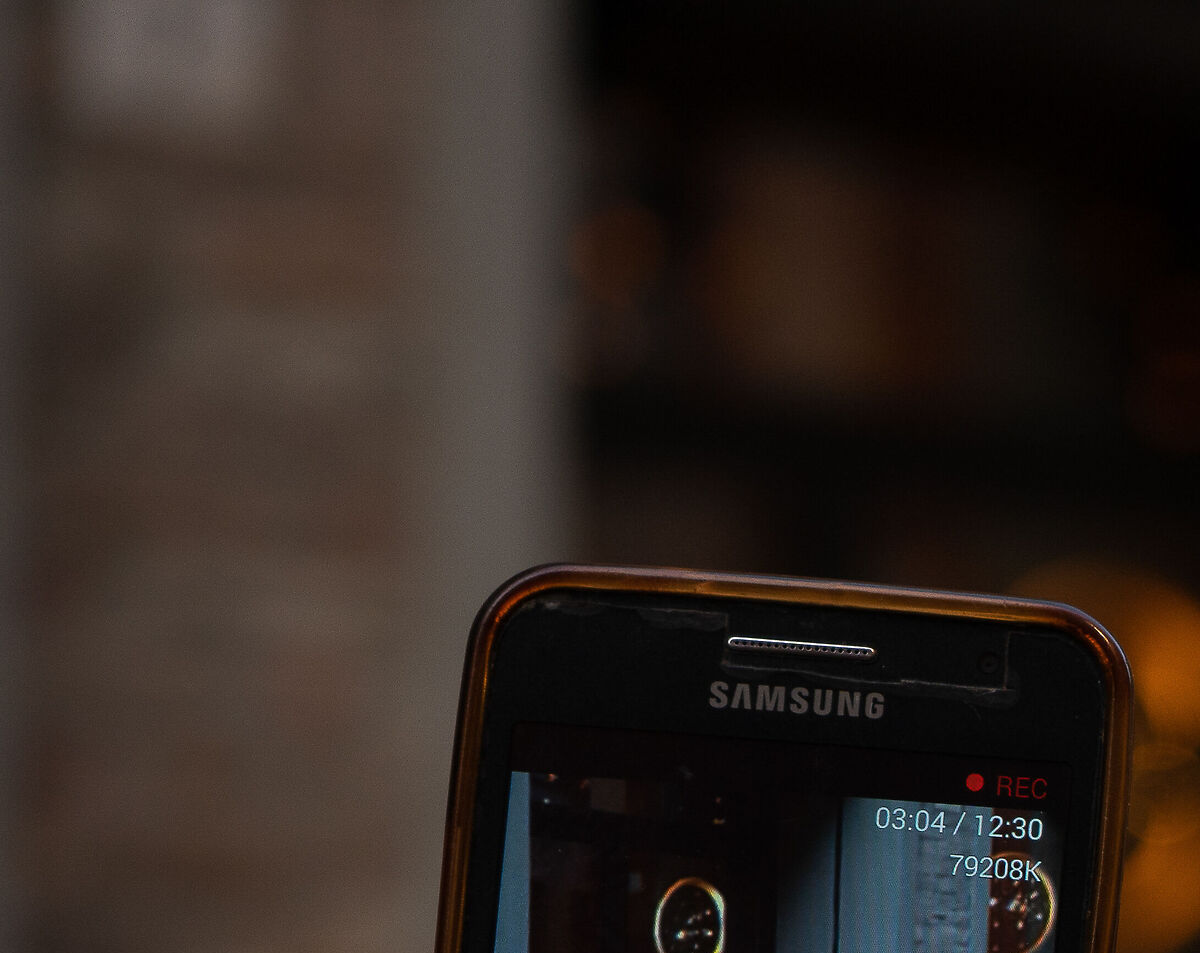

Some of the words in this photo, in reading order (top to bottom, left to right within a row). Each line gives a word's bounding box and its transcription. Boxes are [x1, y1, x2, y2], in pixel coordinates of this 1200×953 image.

[709, 680, 885, 719] SAMSUNG
[996, 775, 1048, 799] REC
[875, 806, 946, 833] 03:04
[974, 814, 1043, 841] 12:30
[950, 854, 1042, 882] 79208K
